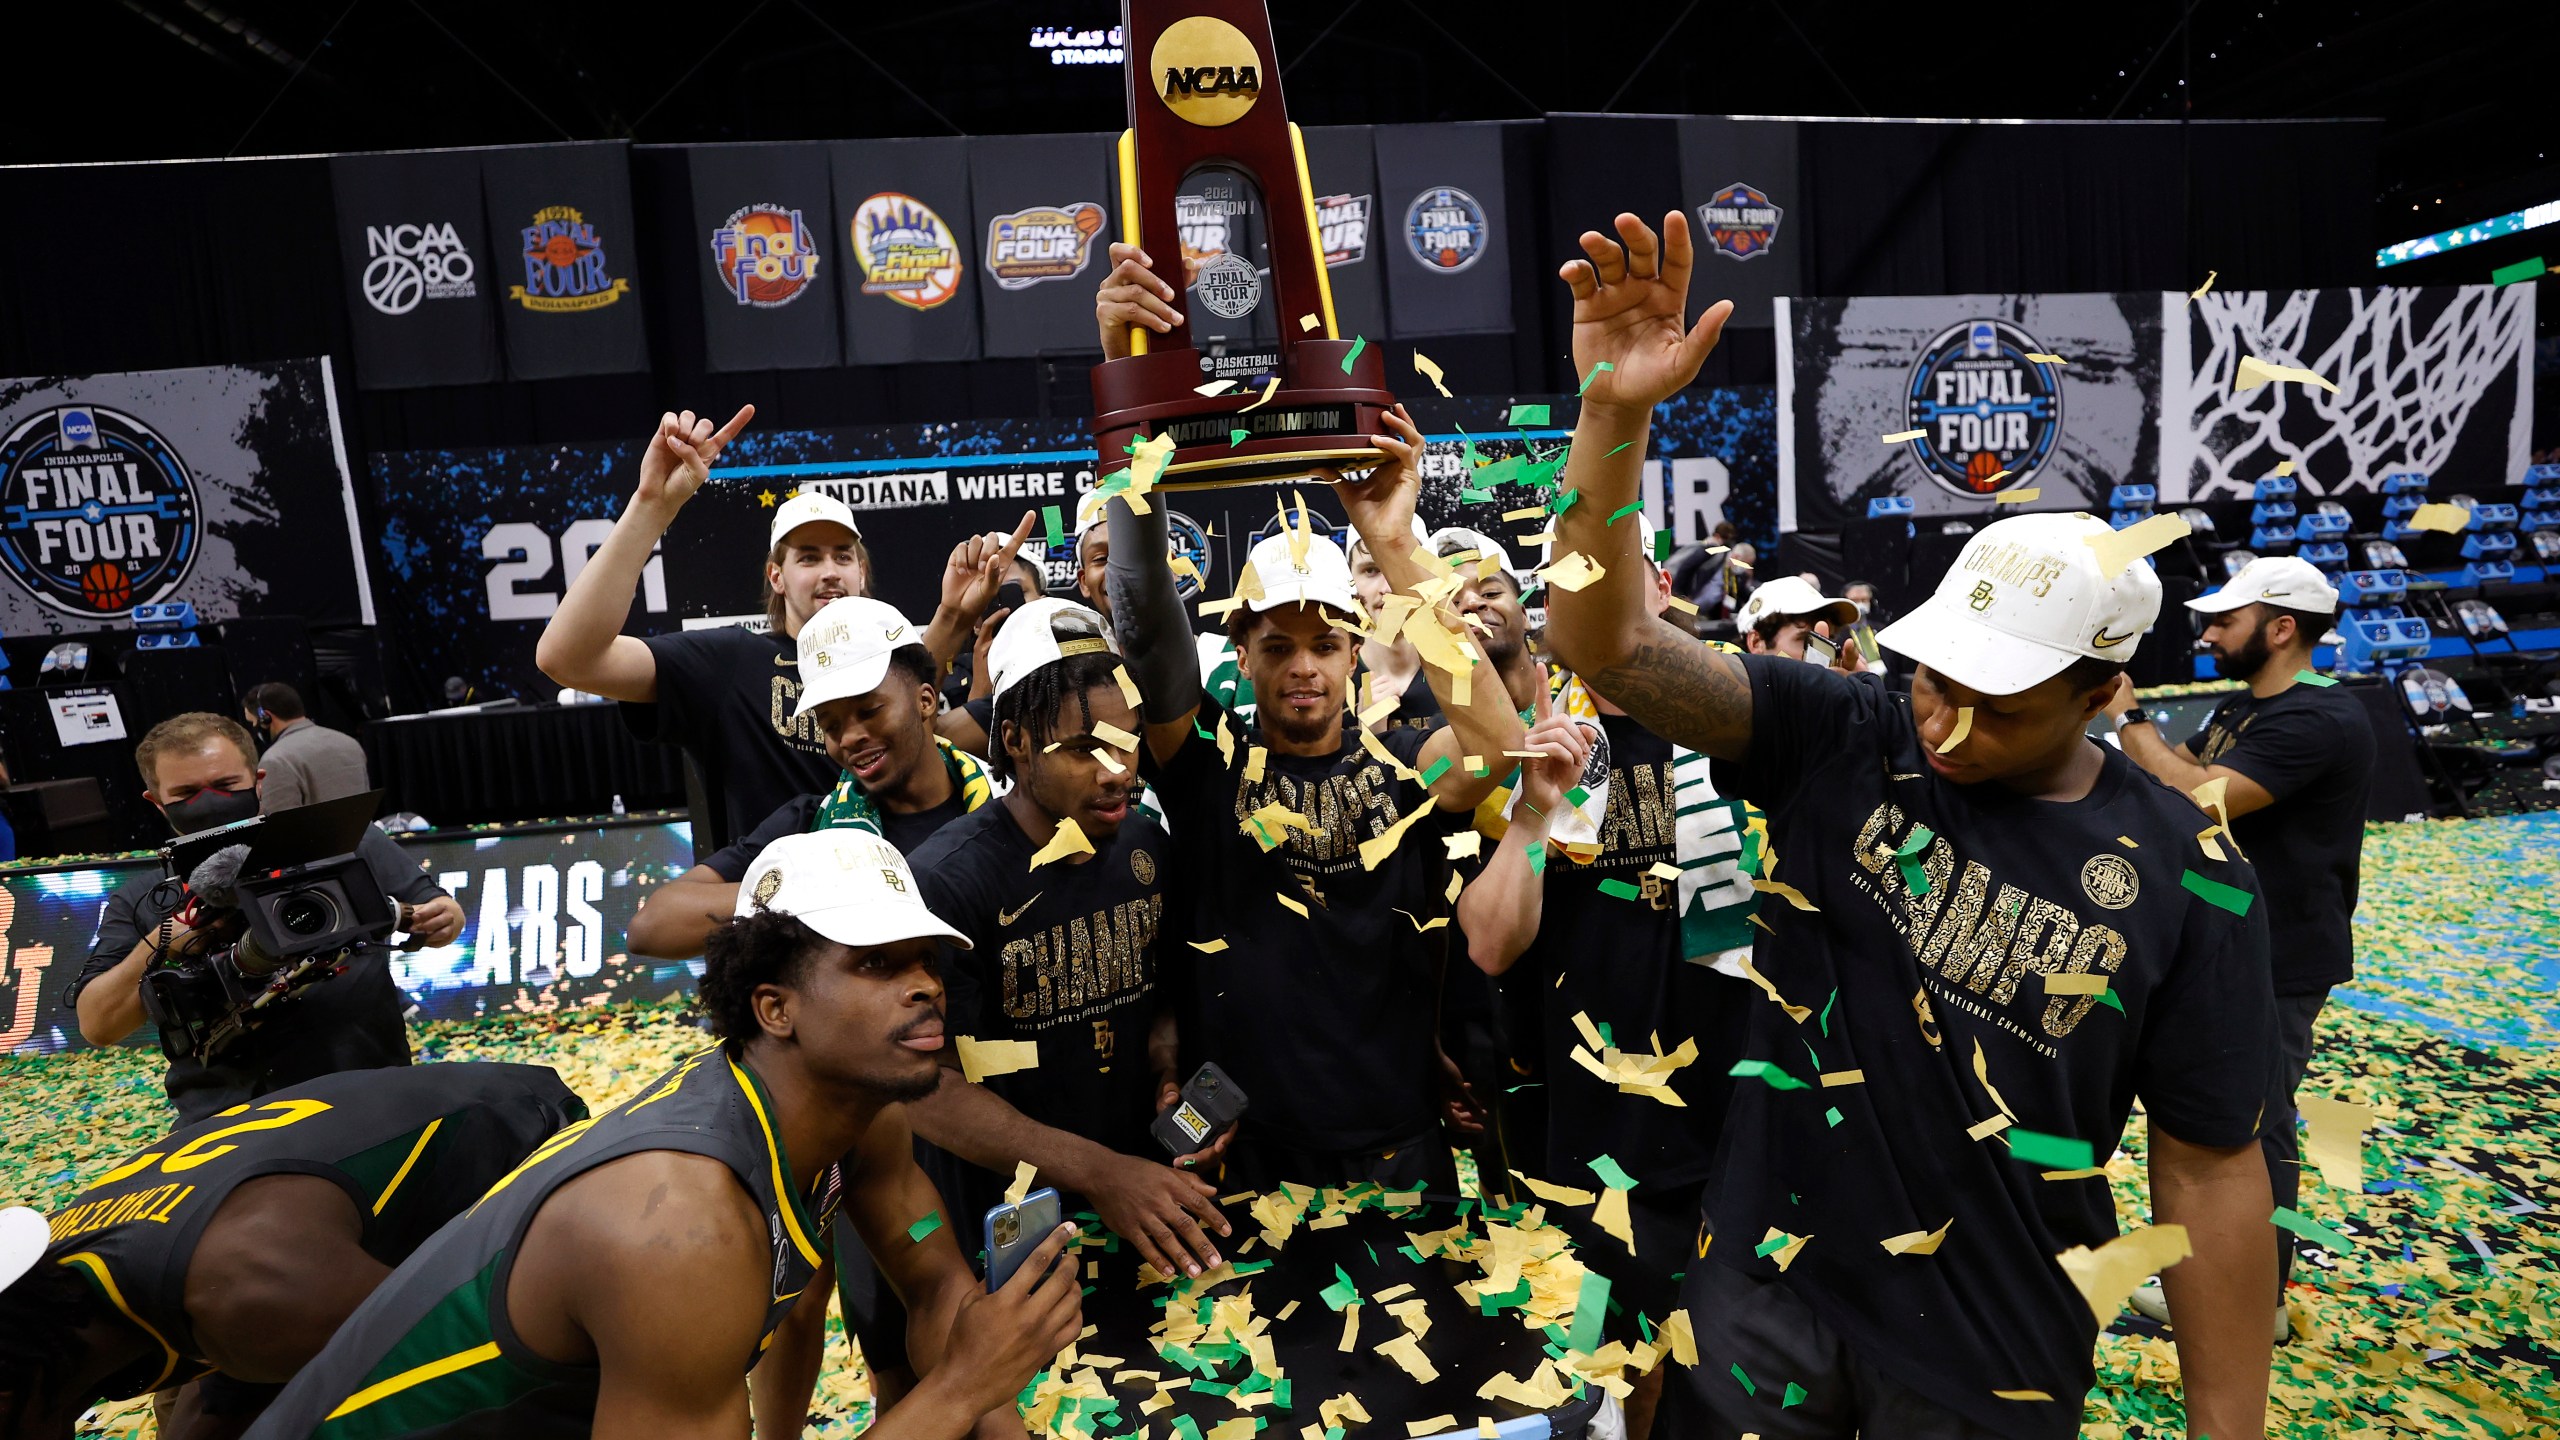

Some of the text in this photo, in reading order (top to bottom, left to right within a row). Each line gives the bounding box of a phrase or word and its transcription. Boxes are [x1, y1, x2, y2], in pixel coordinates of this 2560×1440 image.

[1164, 66, 1260, 100] NCAA
[1204, 187, 1233, 199] 2021
[1187, 201, 1247, 217] DIVISION
[1421, 209, 1470, 229] FINAL
[1704, 207, 1777, 224] FINAL FOUR
[367, 222, 465, 260] NCAA
[521, 220, 601, 249] FINAL
[711, 209, 811, 264] Final
[1016, 223, 1078, 241] FINAL
[1424, 230, 1472, 250] FOUR
[886, 248, 951, 269] Final
[996, 238, 1078, 261] FOUR
[523, 248, 612, 297] FOUR
[732, 255, 820, 306] Four
[1209, 271, 1247, 285] FINAL
[1211, 286, 1249, 301] FOUR
[1215, 366, 1269, 378] CHAMPIONSHIP
[1216, 354, 1279, 370] BASKETBALL
[1953, 360, 2014, 370] INDIANAPOLIS
[1935, 368, 2032, 407] FINAL
[66, 425, 93, 435] NCAA
[1253, 411, 1340, 434] CHAMPION
[1939, 412, 2030, 454] FOUR
[44, 453, 125, 467] INDIANAPOLIS
[21, 463, 155, 510] FINAL
[956, 472, 1066, 500] WHERE
[33, 513, 162, 566] FOUR
[64, 560, 142, 576] 20 21
[1964, 544, 2061, 598] CHAMPS
[1968, 579, 1995, 612] BU
[816, 651, 832, 668] BU
[1620, 851, 1666, 867] BASKETBALL
[881, 869, 907, 893] BU
[1849, 872, 1872, 893] 2021
[2091, 875, 2125, 899] FOUR
[2096, 864, 2128, 888] FINAL
[1637, 869, 1672, 912] BU
[1943, 988, 1994, 1022] NATIONAL
[1996, 1015, 2058, 1060] CHAMPIONS
[1172, 1115, 1201, 1142] CHAMPIONS
